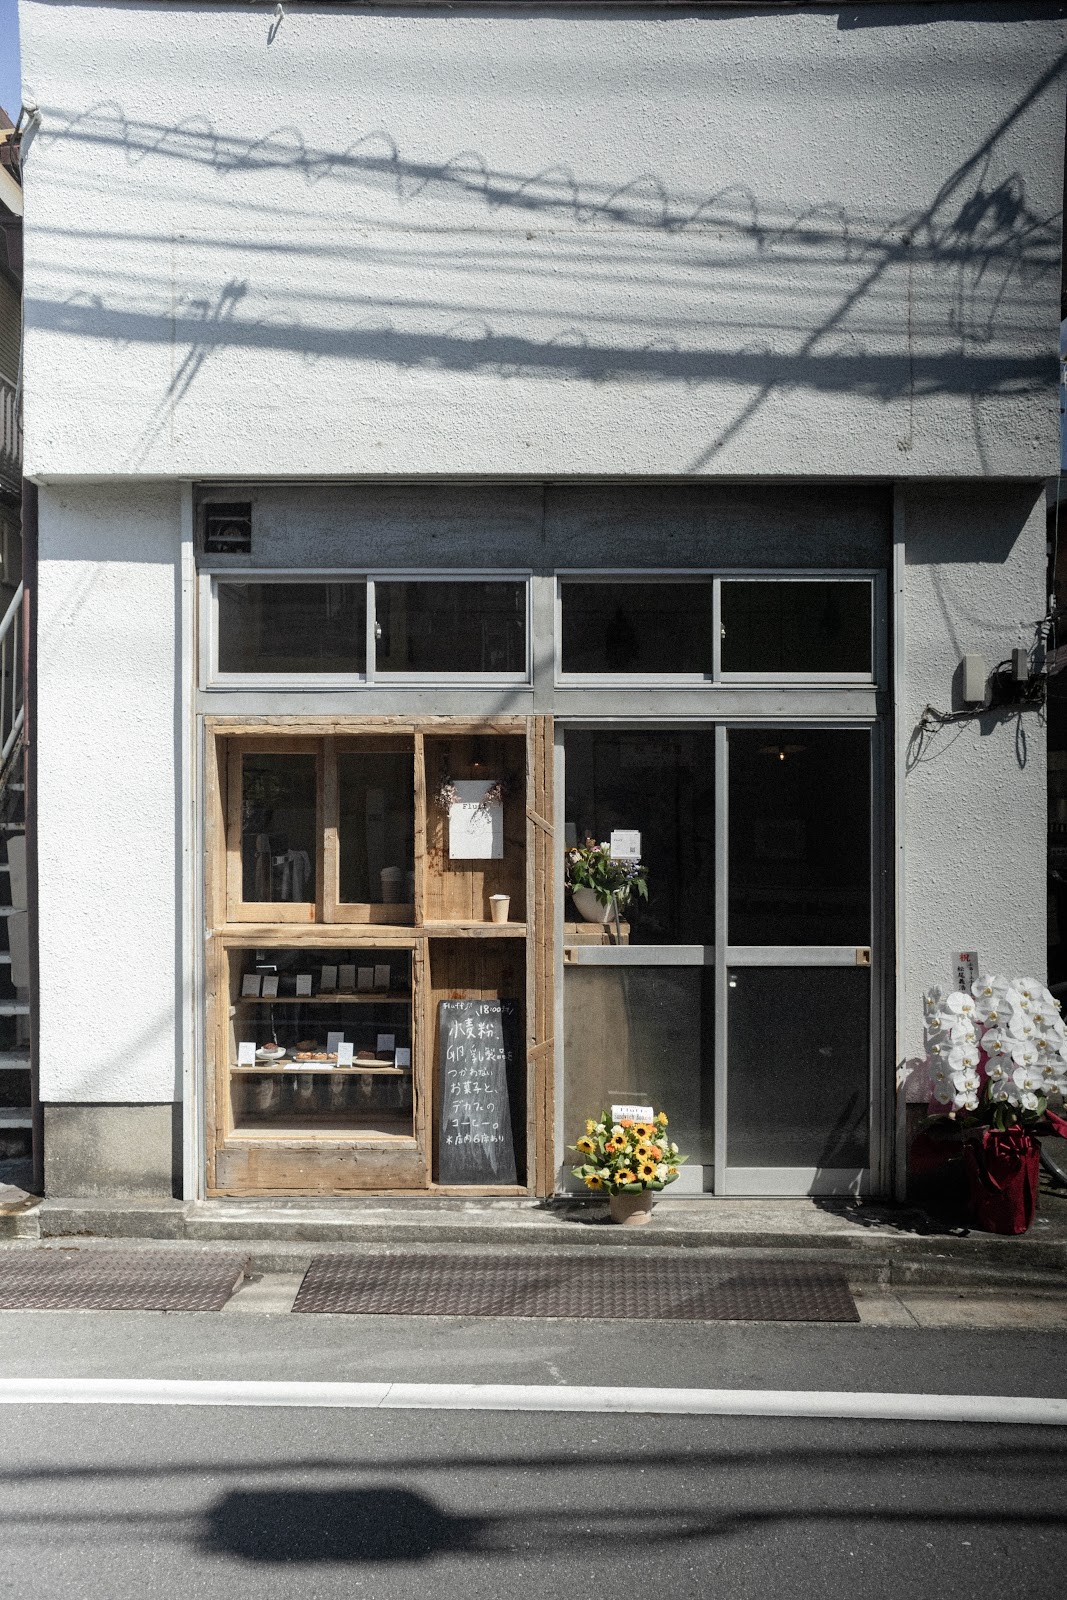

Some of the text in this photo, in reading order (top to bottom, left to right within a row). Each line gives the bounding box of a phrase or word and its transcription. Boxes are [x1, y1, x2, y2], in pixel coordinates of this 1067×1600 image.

[959, 954, 971, 962] 祝
[452, 1100, 495, 1113] デカフェの
